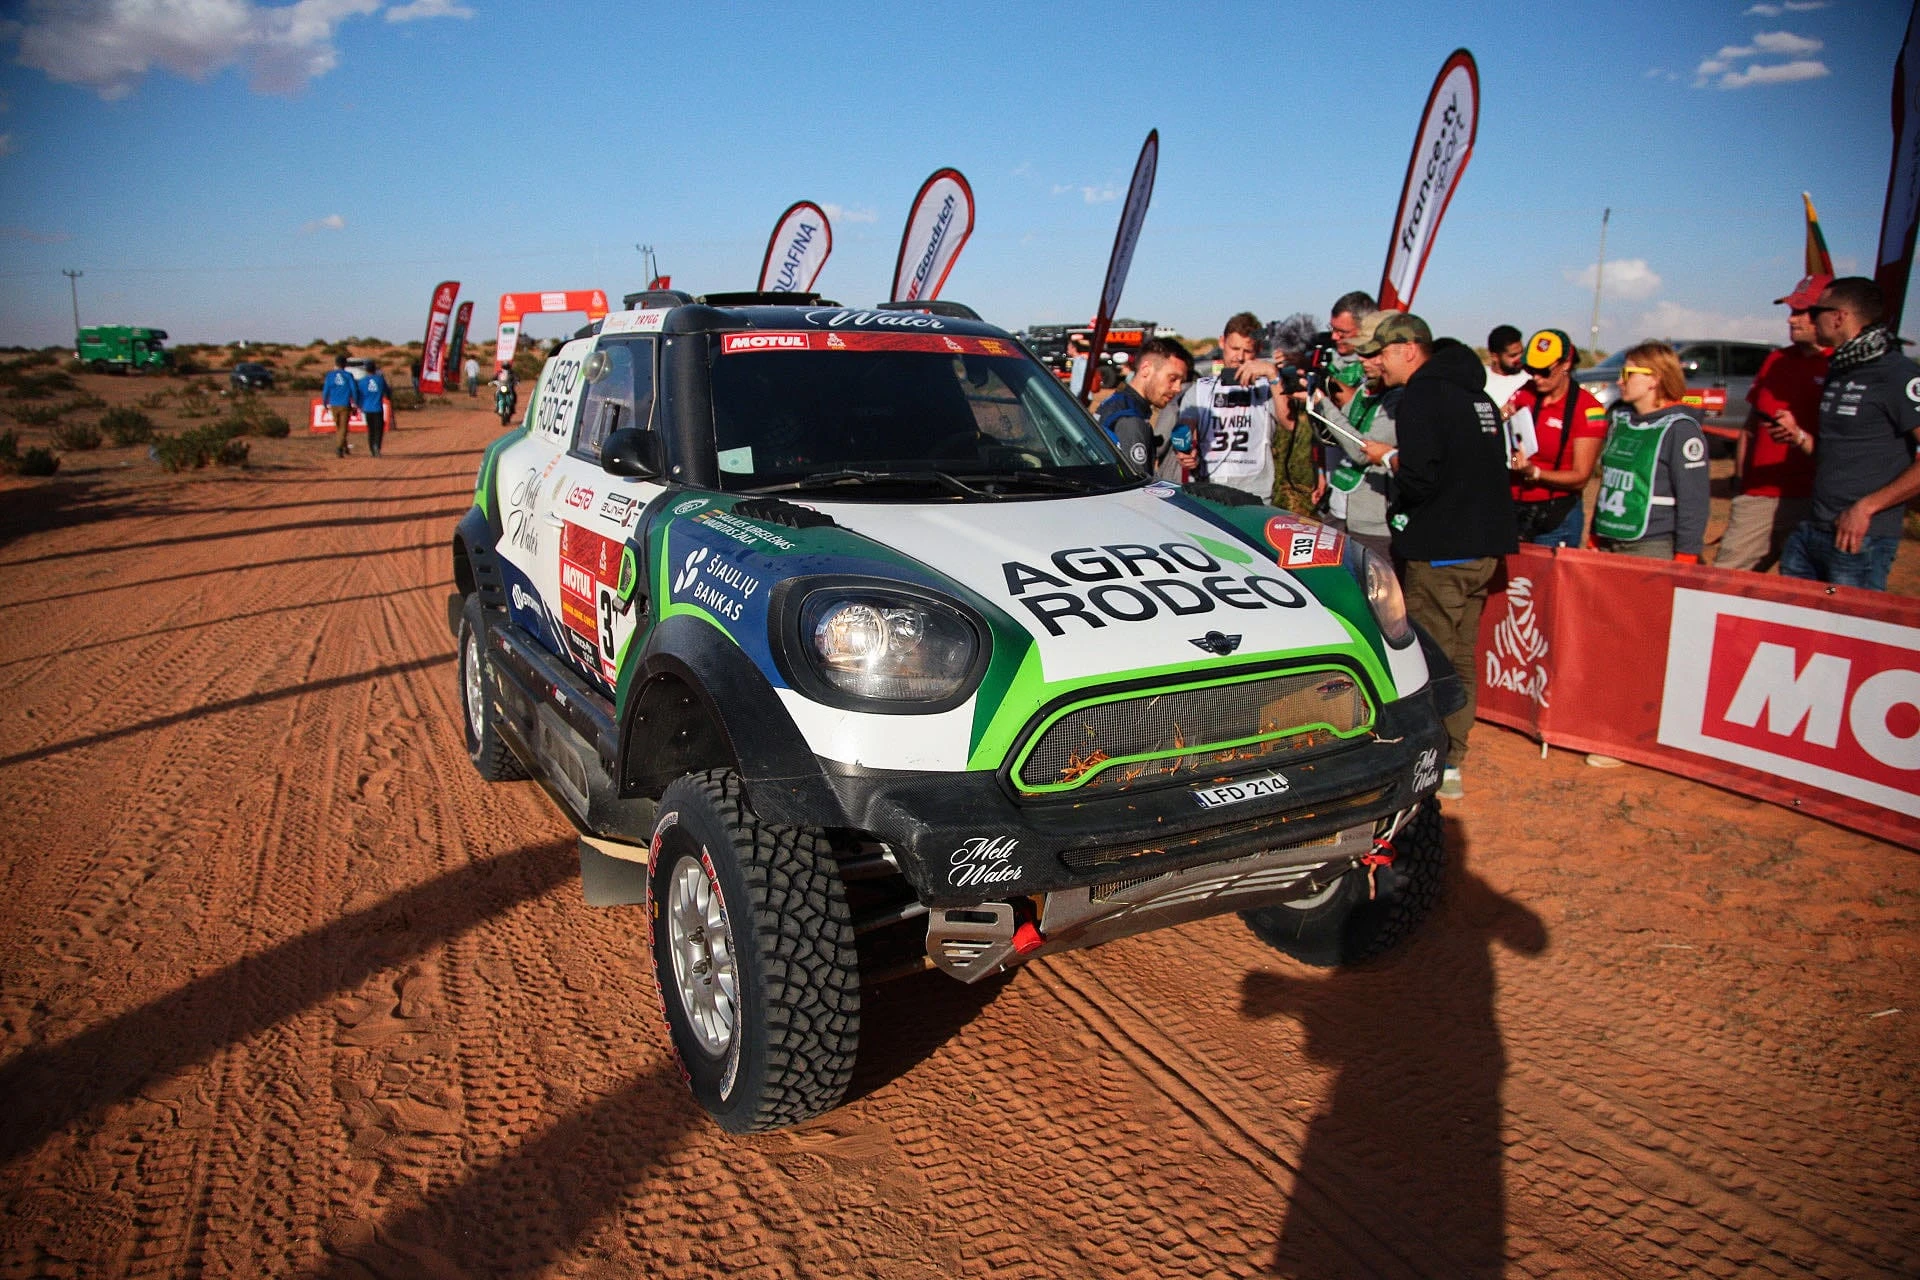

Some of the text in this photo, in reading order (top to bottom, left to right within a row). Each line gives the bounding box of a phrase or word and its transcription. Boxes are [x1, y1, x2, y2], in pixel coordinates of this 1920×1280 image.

[804, 310, 945, 329] Water
[729, 336, 805, 349] MOTUL
[544, 360, 581, 395] AGRO
[536, 397, 573, 437] RODEO
[1211, 431, 1249, 452] 32
[1292, 538, 1313, 557] 319
[563, 562, 592, 599] MOTUL
[706, 553, 759, 599] ŠIAULIŲ
[1001, 543, 1221, 595] AGRO
[693, 581, 743, 621] BANKAS
[1018, 575, 1307, 637] RODEO
[1485, 649, 1550, 708] DAKAR
[1724, 641, 1920, 770] MO
[1201, 778, 1287, 805] LFD 214
[950, 835, 1020, 866] Melt
[947, 858, 1023, 887] Water
